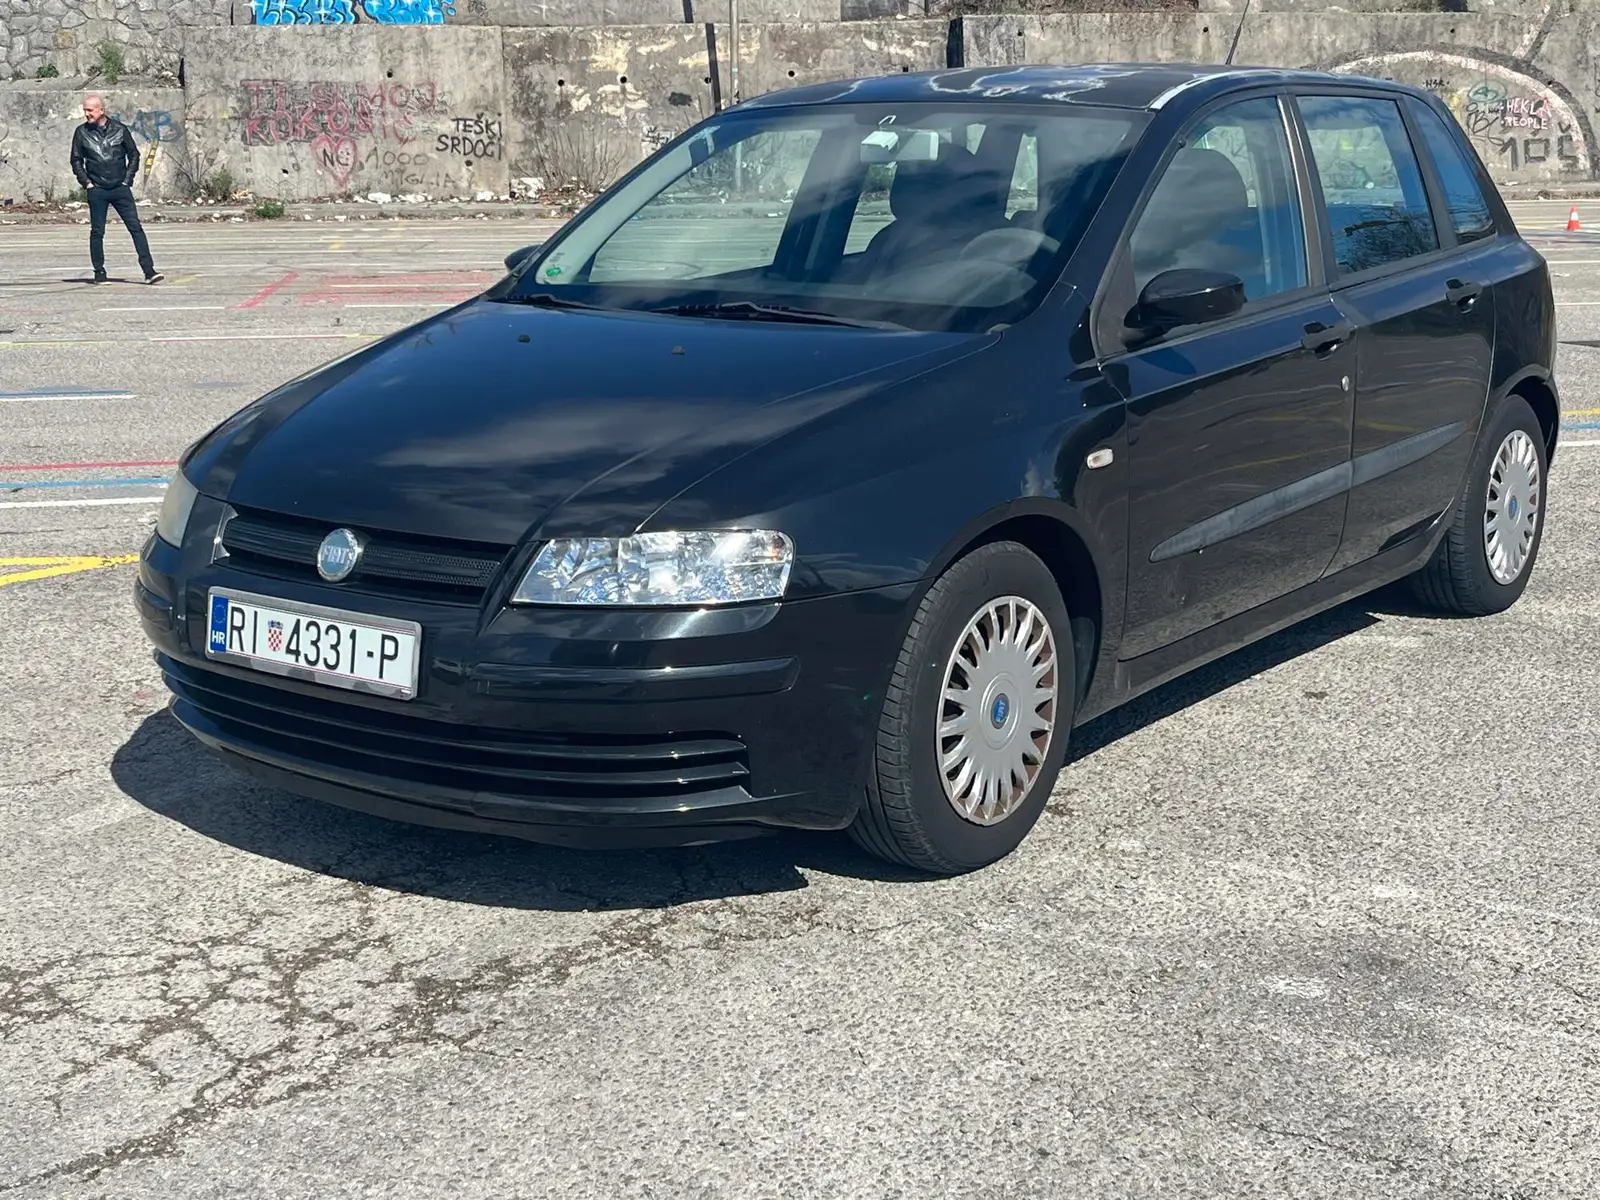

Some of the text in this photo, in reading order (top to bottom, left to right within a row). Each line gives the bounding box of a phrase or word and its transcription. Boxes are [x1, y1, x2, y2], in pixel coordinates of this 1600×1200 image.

[1506, 97, 1552, 118] HEKLA
[450, 112, 503, 139] TEŠKI
[1504, 116, 1549, 130] PEOPLE
[365, 146, 430, 170] 1000
[211, 630, 226, 645] HR
[228, 605, 400, 680] RI 4331-P
